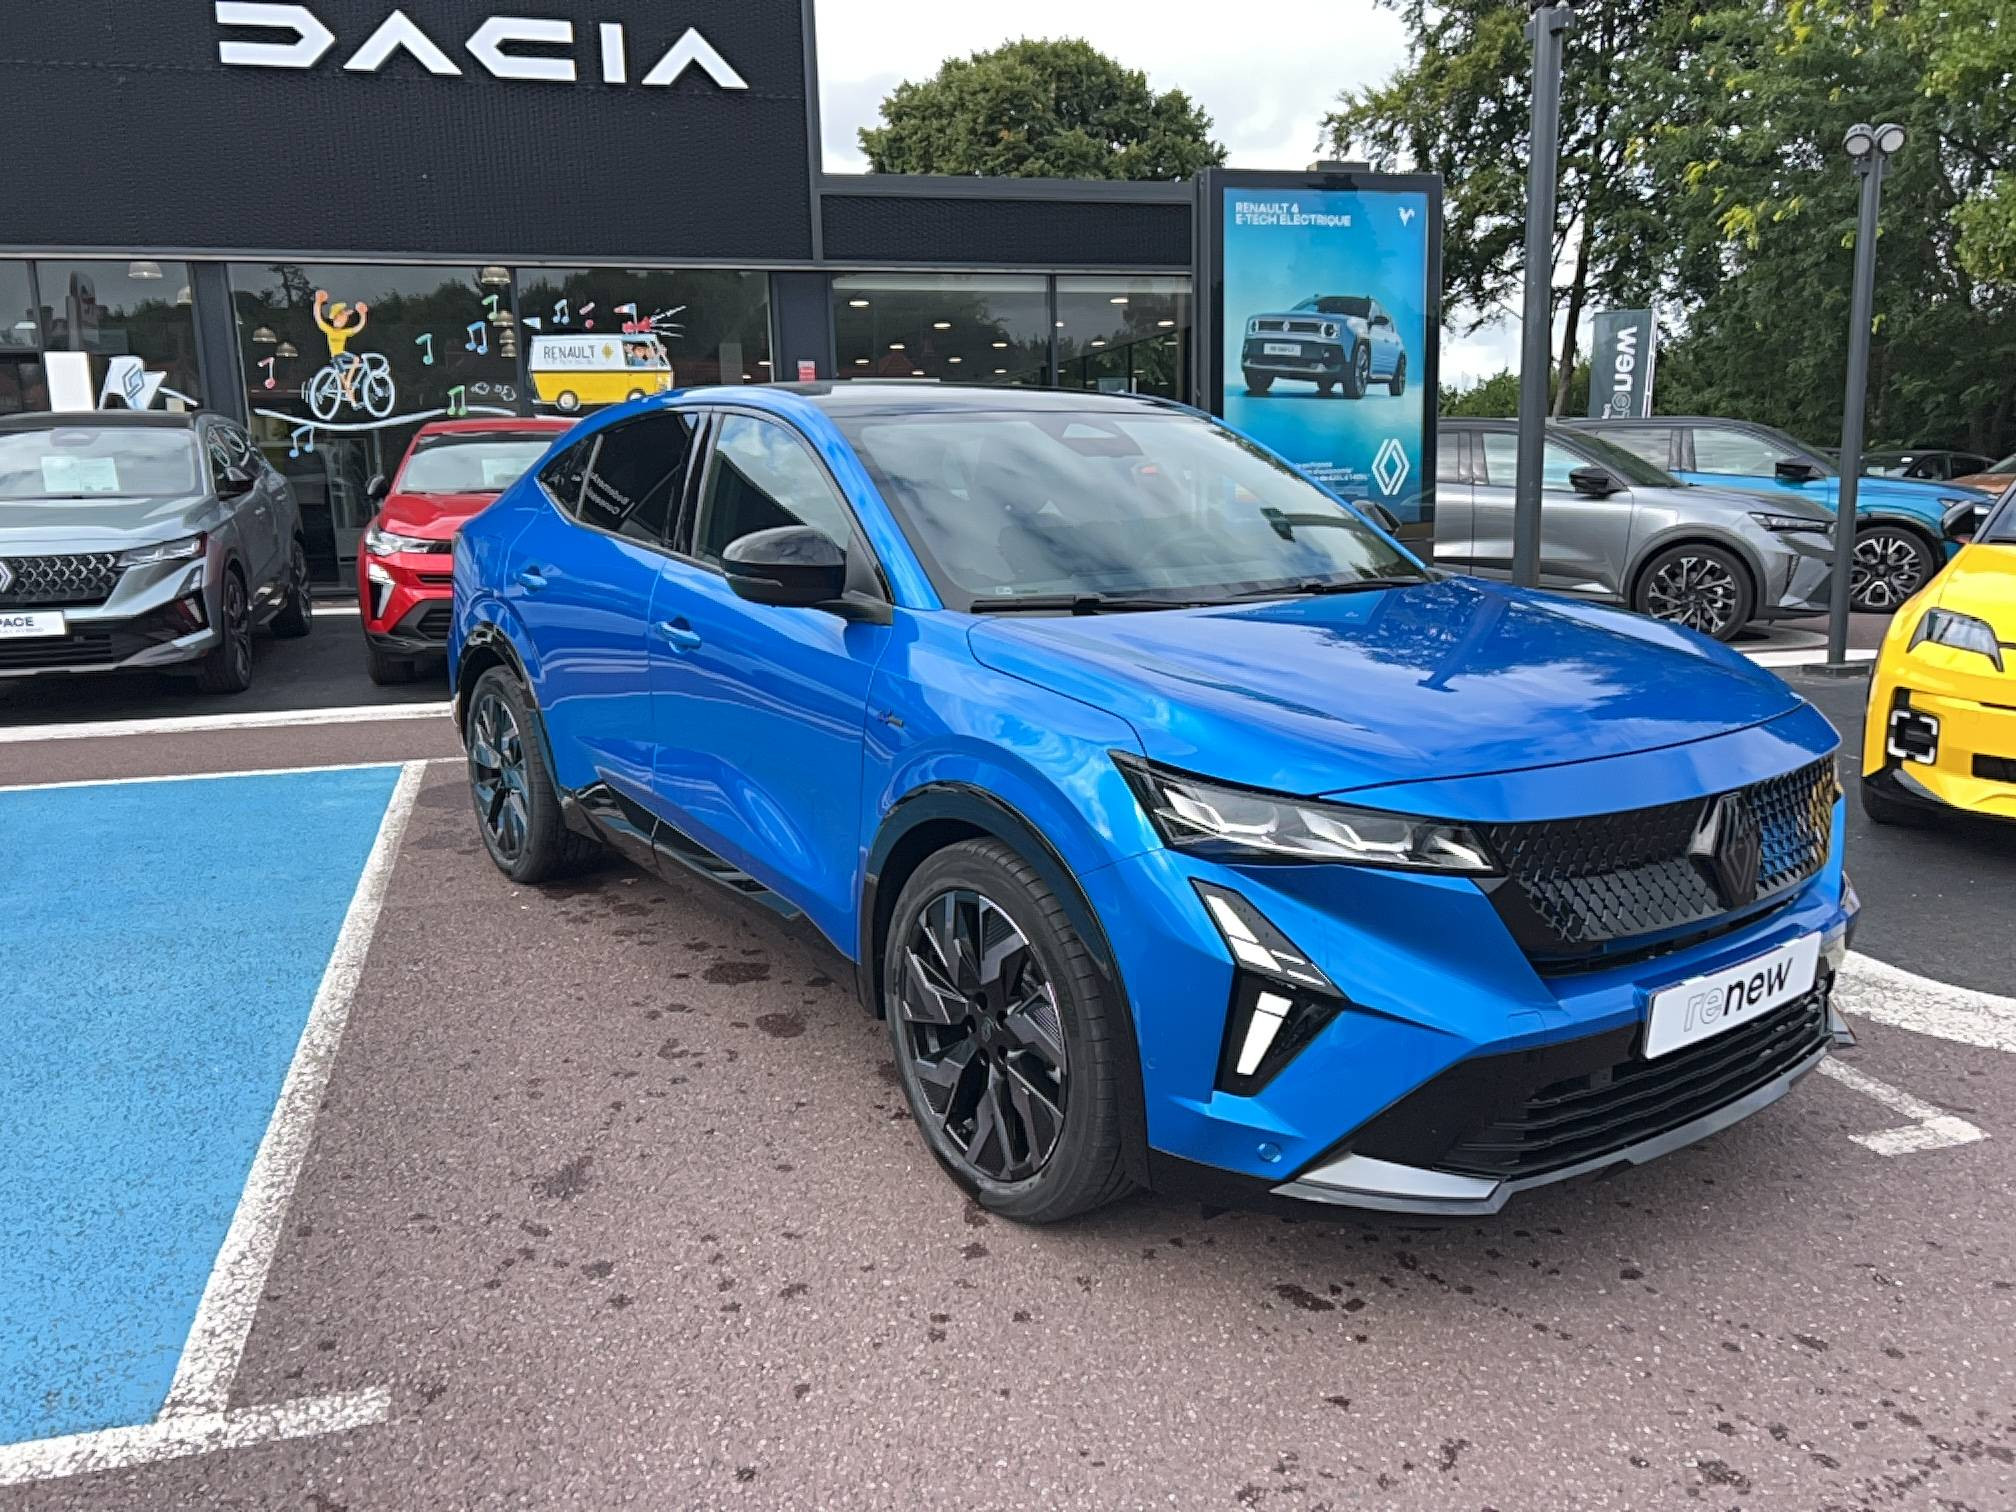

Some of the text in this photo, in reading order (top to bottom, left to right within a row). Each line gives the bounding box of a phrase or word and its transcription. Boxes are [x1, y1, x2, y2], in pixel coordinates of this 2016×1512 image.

[215, 1, 749, 90] DACIA
[1235, 202, 1290, 214] RENAULT
[1235, 213, 1277, 225] E-TECH
[543, 345, 596, 360] RENAULT
[1683, 957, 1792, 1032] renew
